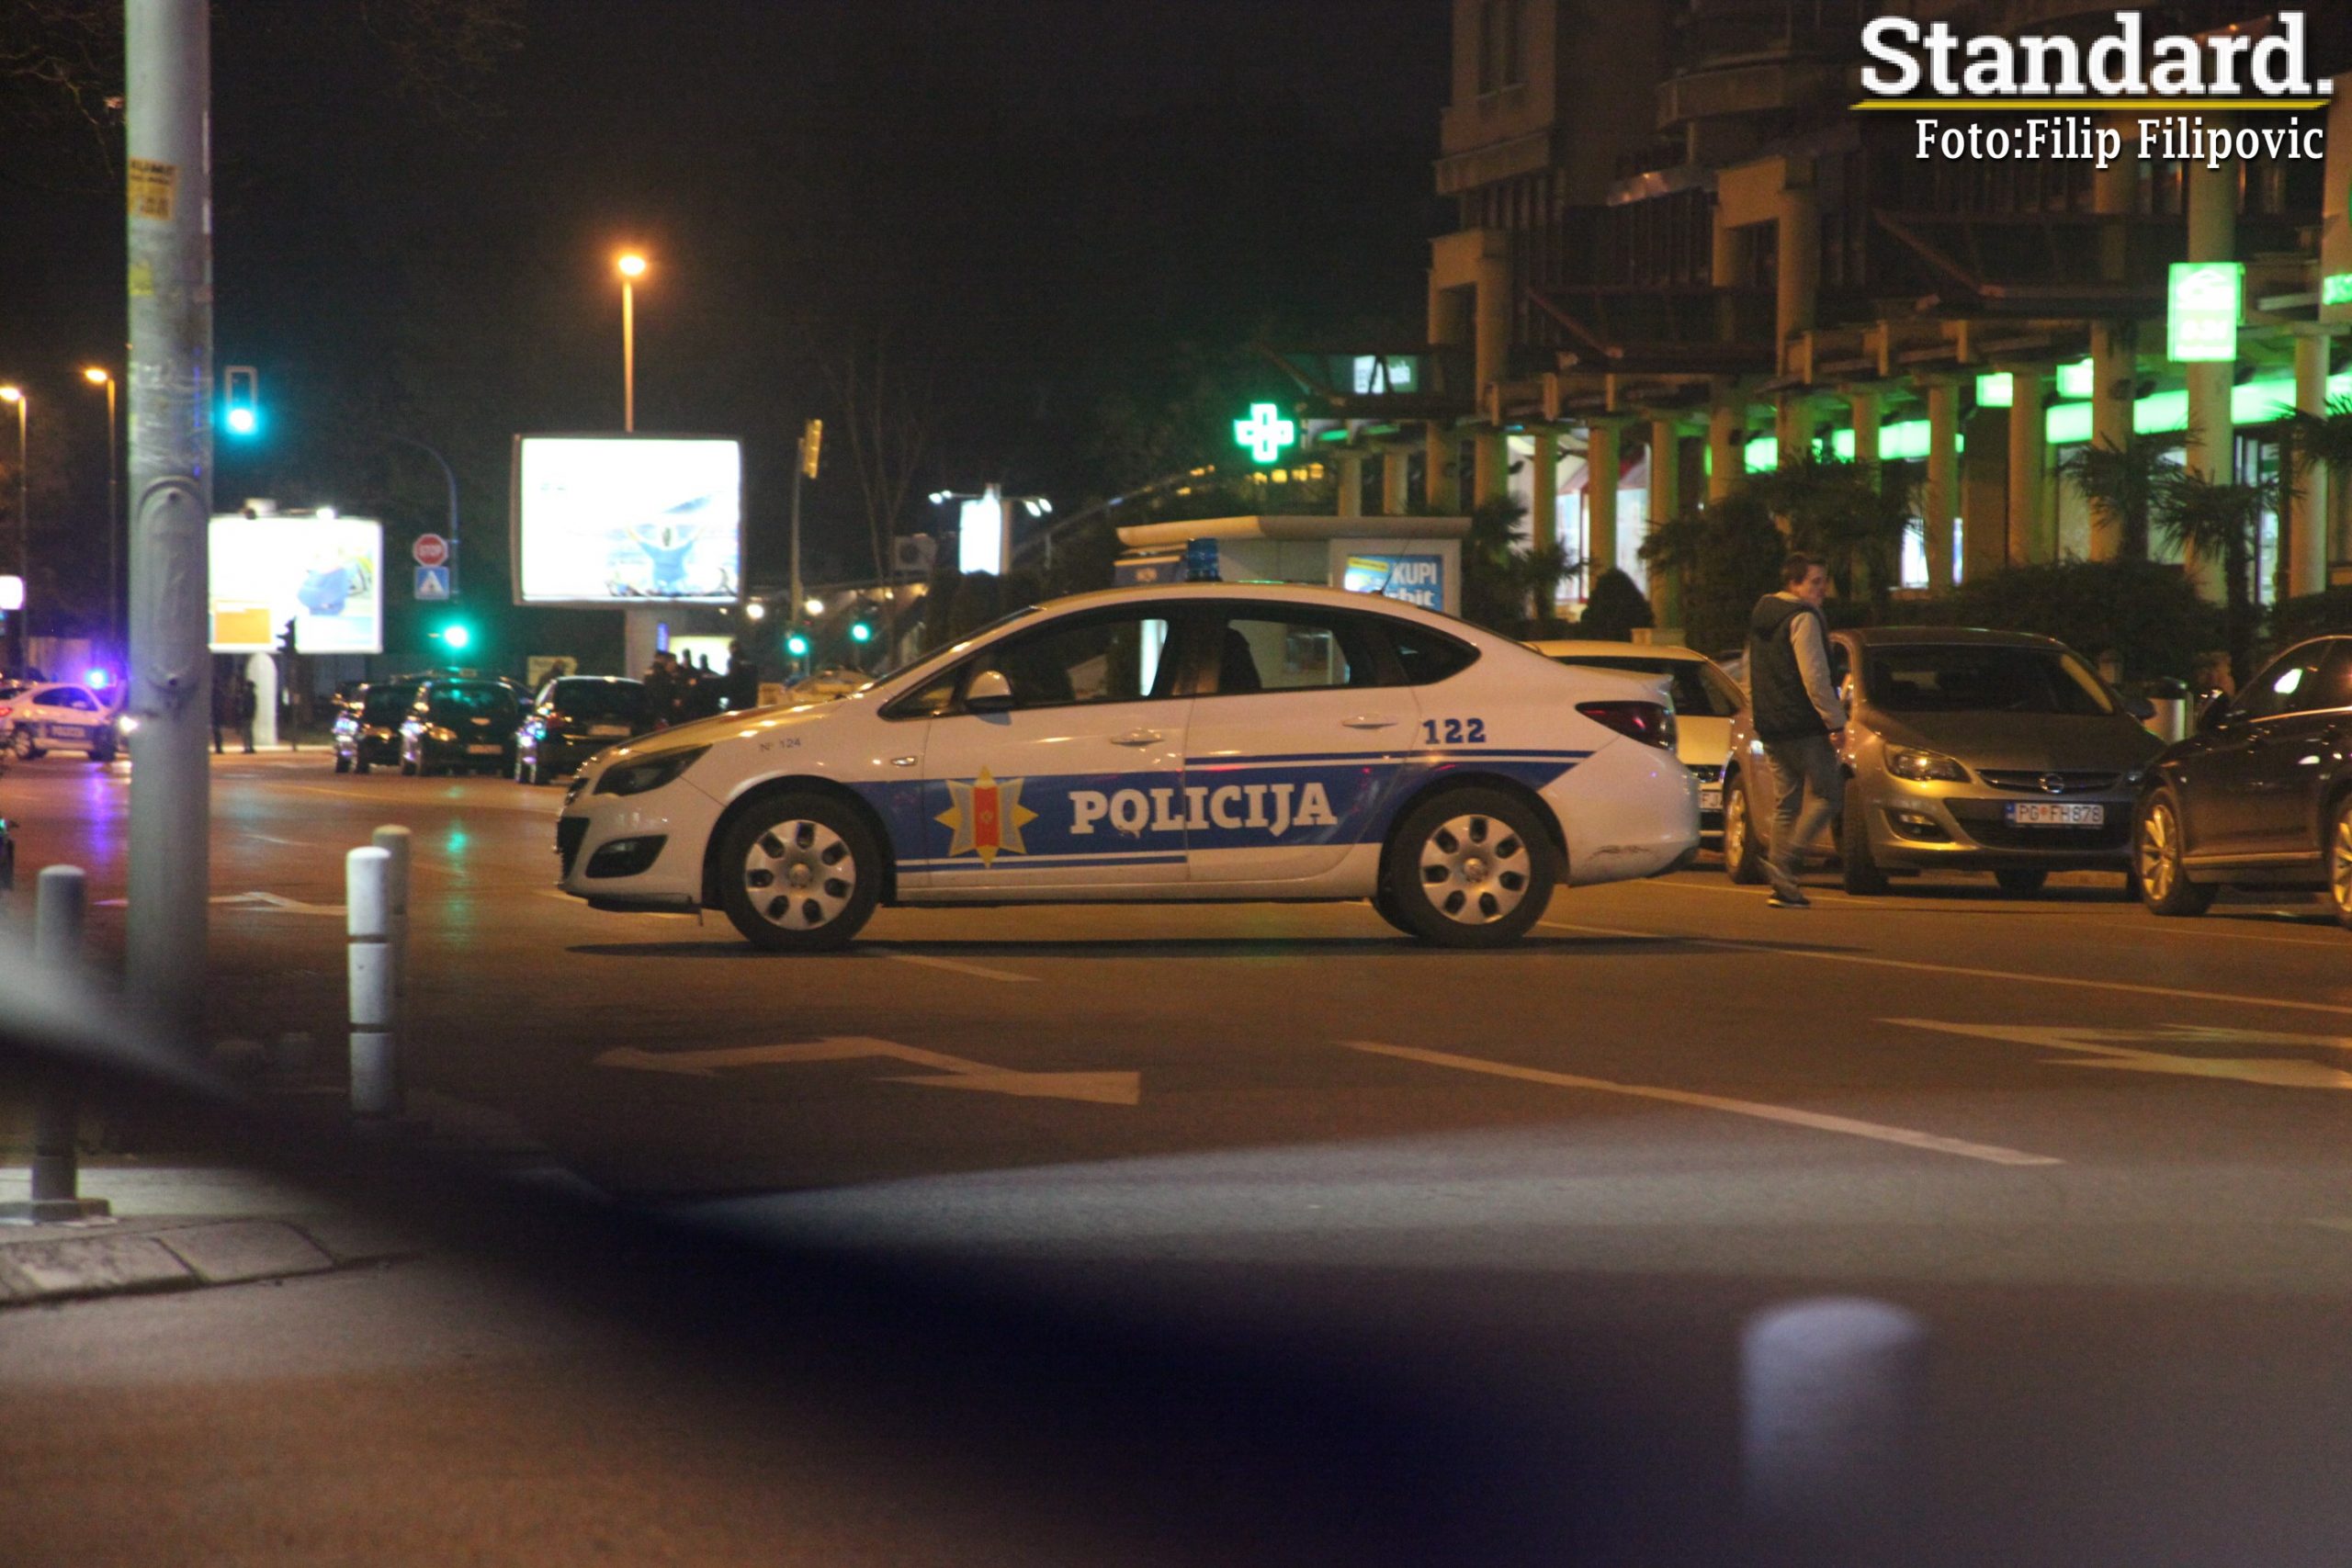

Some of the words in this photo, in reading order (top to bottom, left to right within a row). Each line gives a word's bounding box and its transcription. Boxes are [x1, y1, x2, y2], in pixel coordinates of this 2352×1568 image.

[1392, 561, 1438, 585] KUPI
[1422, 717, 1487, 745] 122
[1068, 782, 1339, 839] POLICIJA
